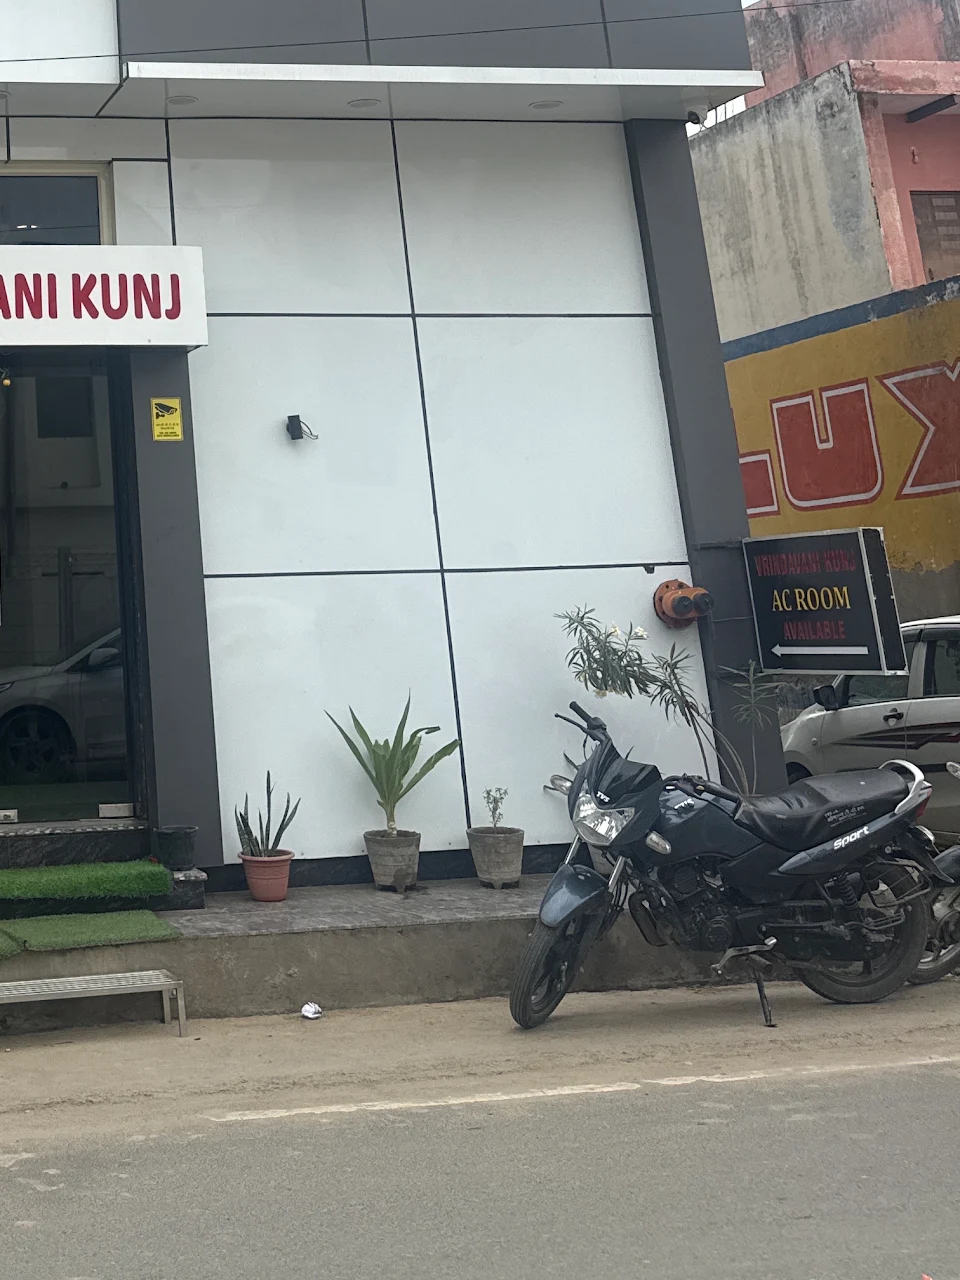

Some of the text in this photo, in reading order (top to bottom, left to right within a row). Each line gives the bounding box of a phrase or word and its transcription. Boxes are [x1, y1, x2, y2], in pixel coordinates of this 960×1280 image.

[72, 273, 181, 320] KUNJ
[754, 549, 857, 576] VRINDAVANI KUNJ
[772, 586, 851, 611] AC ROOM
[783, 620, 846, 640] AVAILABLE
[596, 791, 611, 803] TVS
[834, 826, 870, 850] Sport
